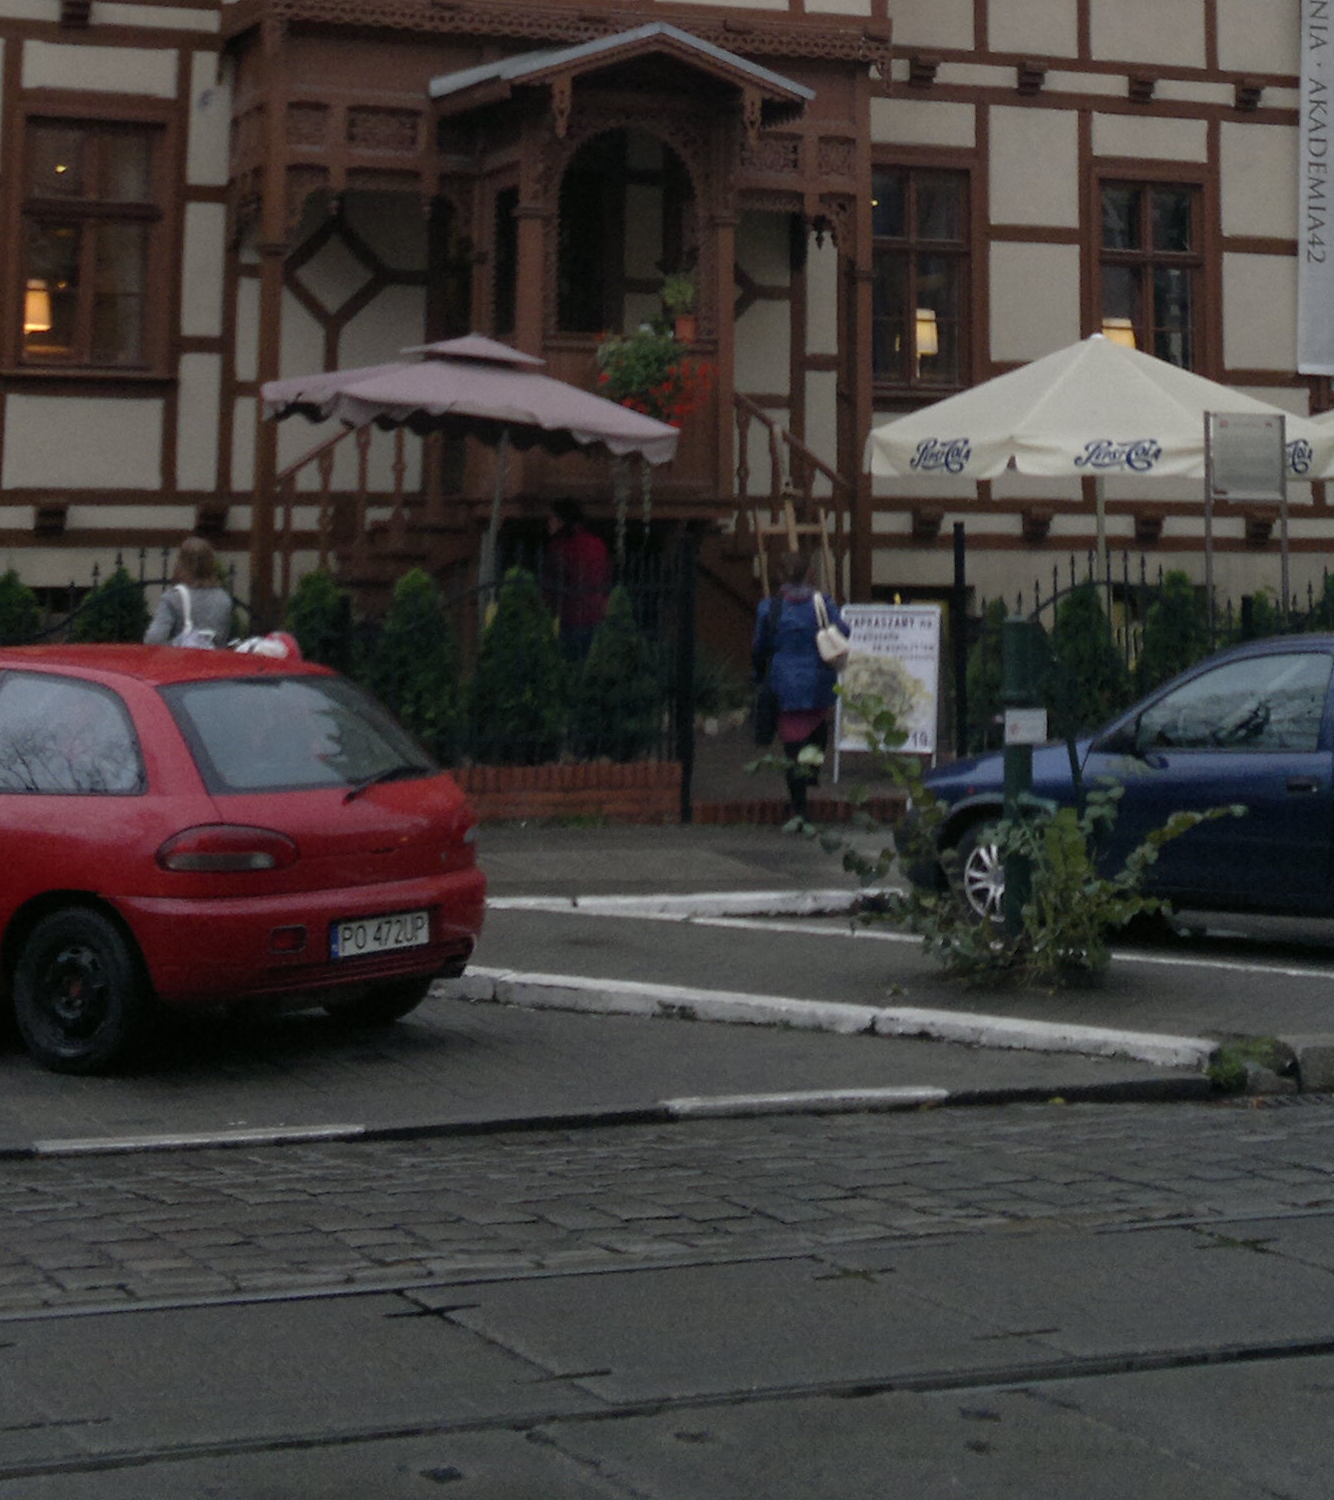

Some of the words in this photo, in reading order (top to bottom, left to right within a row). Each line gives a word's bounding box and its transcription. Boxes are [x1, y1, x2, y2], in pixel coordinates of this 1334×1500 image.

[1304, 79, 1331, 264] AKADEMIA42
[341, 924, 367, 953] PO
[372, 916, 426, 947] 472UP
